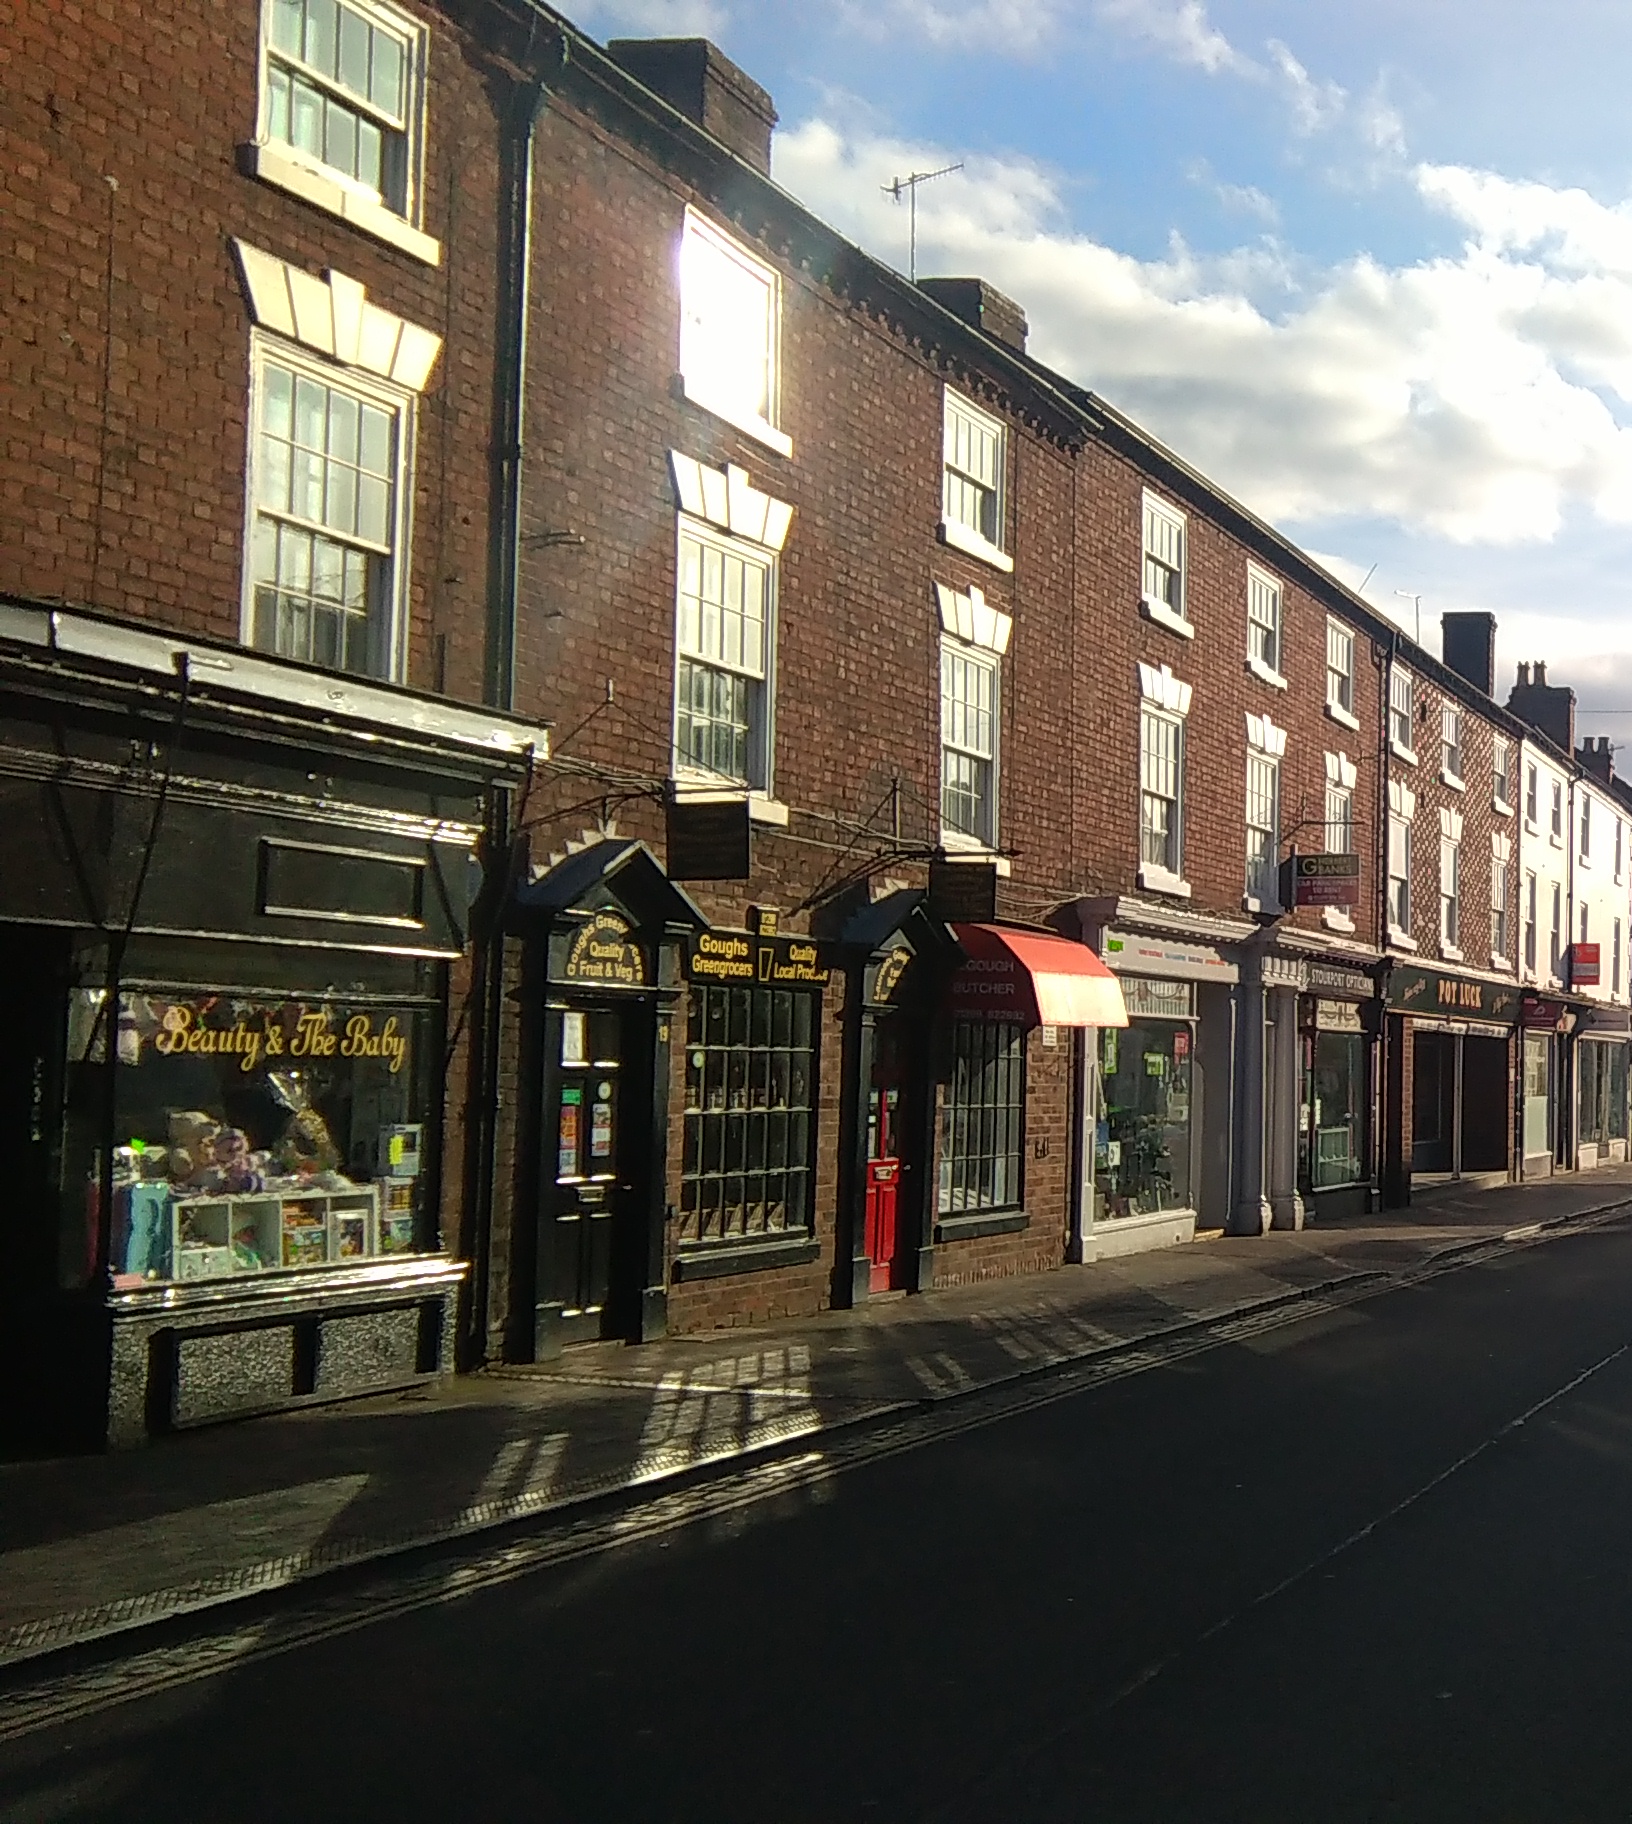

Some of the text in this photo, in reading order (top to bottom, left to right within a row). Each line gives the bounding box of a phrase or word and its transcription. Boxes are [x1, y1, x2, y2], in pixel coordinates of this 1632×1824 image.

[1302, 858, 1319, 875] G
[1318, 865, 1351, 875] BANKS
[589, 942, 625, 962] Quality
[699, 934, 749, 960] Goughs
[789, 944, 818, 965] Quality
[579, 960, 633, 982] Fruit & Veg
[692, 953, 754, 980] Greengrocers
[774, 961, 796, 979] Local
[966, 960, 1015, 972] GOUGH
[1311, 968, 1345, 987] STOURPORT
[953, 982, 1016, 995] BUTCHER
[1438, 979, 1458, 1006] POT
[1459, 981, 1482, 1009] LUCK
[155, 1005, 407, 1074] Beauty & The Baby
